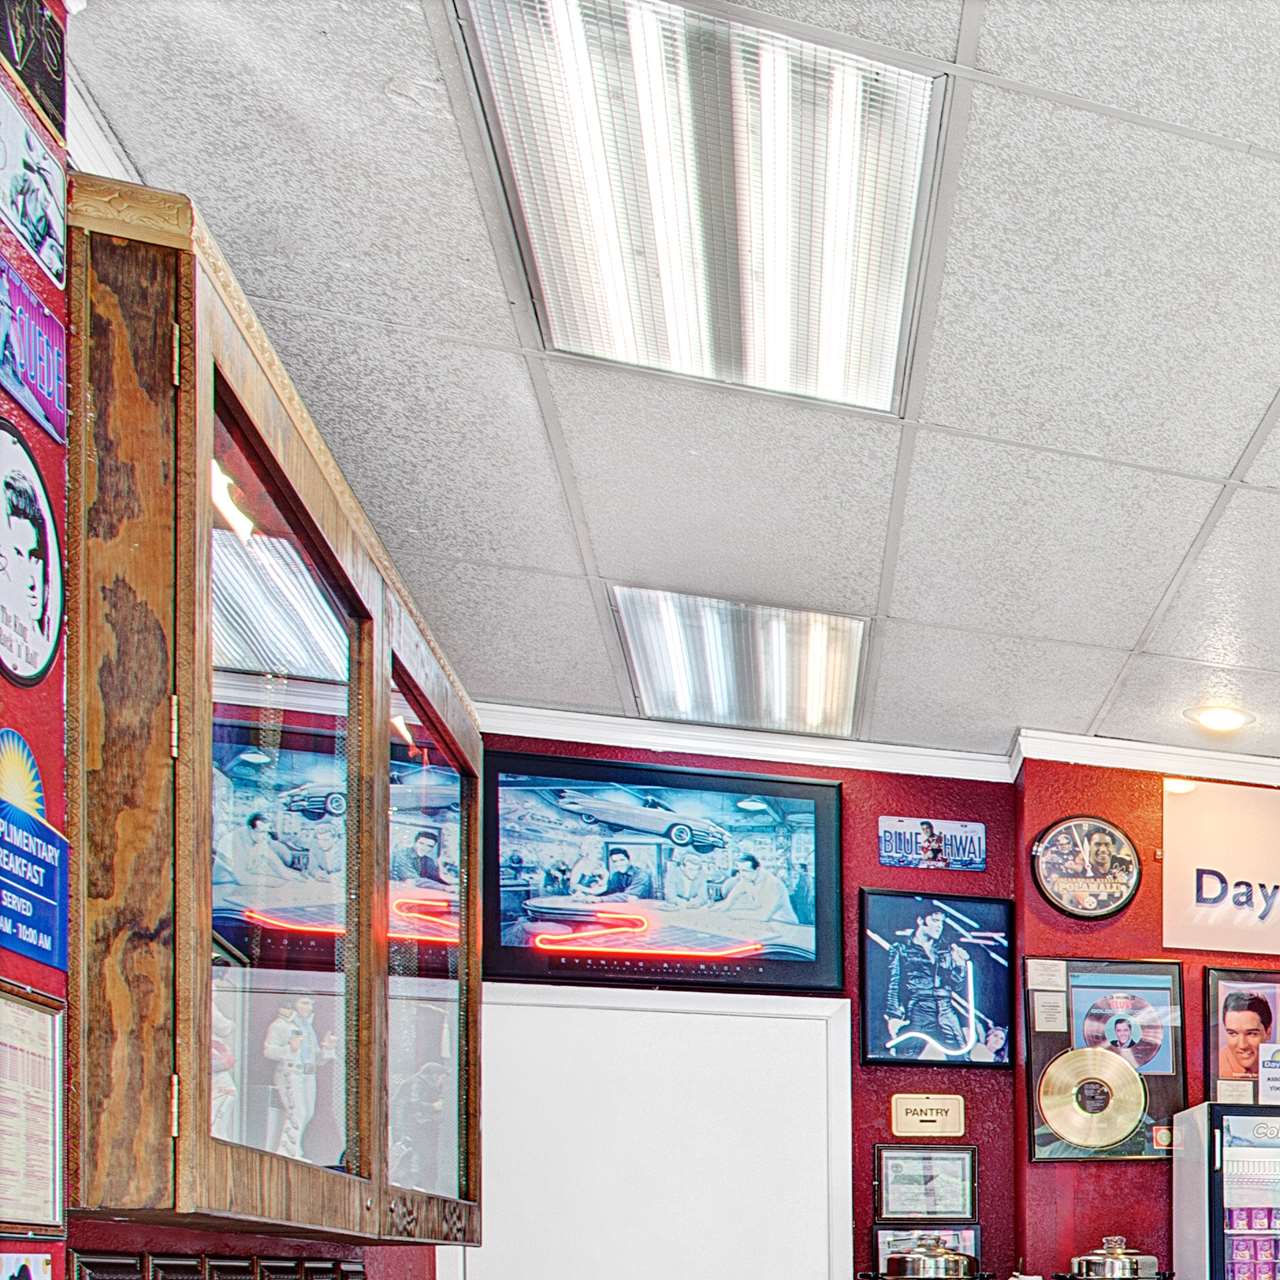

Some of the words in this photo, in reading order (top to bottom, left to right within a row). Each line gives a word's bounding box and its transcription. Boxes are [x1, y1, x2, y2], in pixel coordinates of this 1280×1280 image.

[17, 305, 64, 413] SUEDE
[883, 830, 921, 857] BLUE
[2, 889, 33, 917] SERVED
[16, 923, 38, 946] 10:00
[37, 932, 53, 952] AM
[904, 1107, 950, 1118] PANTRY
